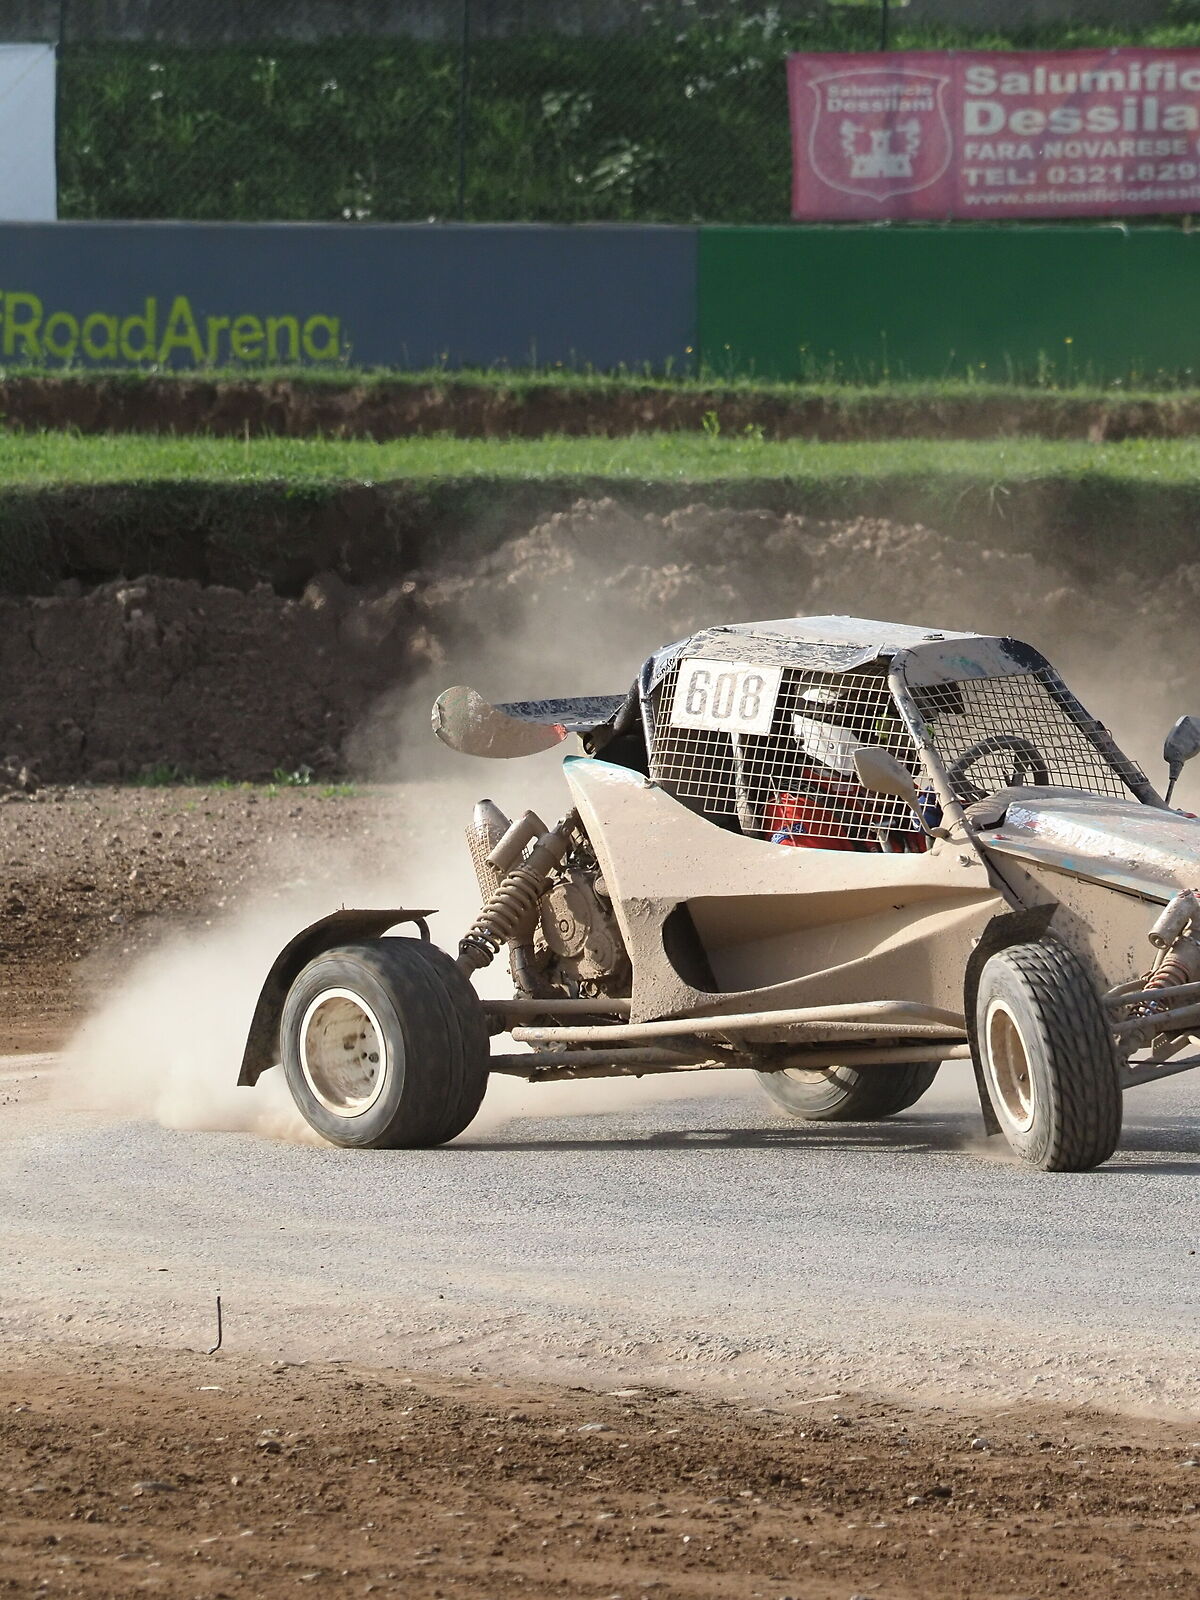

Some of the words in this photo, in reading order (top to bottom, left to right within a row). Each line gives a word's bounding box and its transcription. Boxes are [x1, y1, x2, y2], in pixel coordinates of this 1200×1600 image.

[827, 97, 935, 112] Dessilani
[964, 141, 1035, 160] FARA
[1043, 138, 1187, 159] NOVARESE
[965, 166, 1037, 186] TEL:
[0, 288, 341, 362] RoadArena
[685, 669, 765, 721] 608
